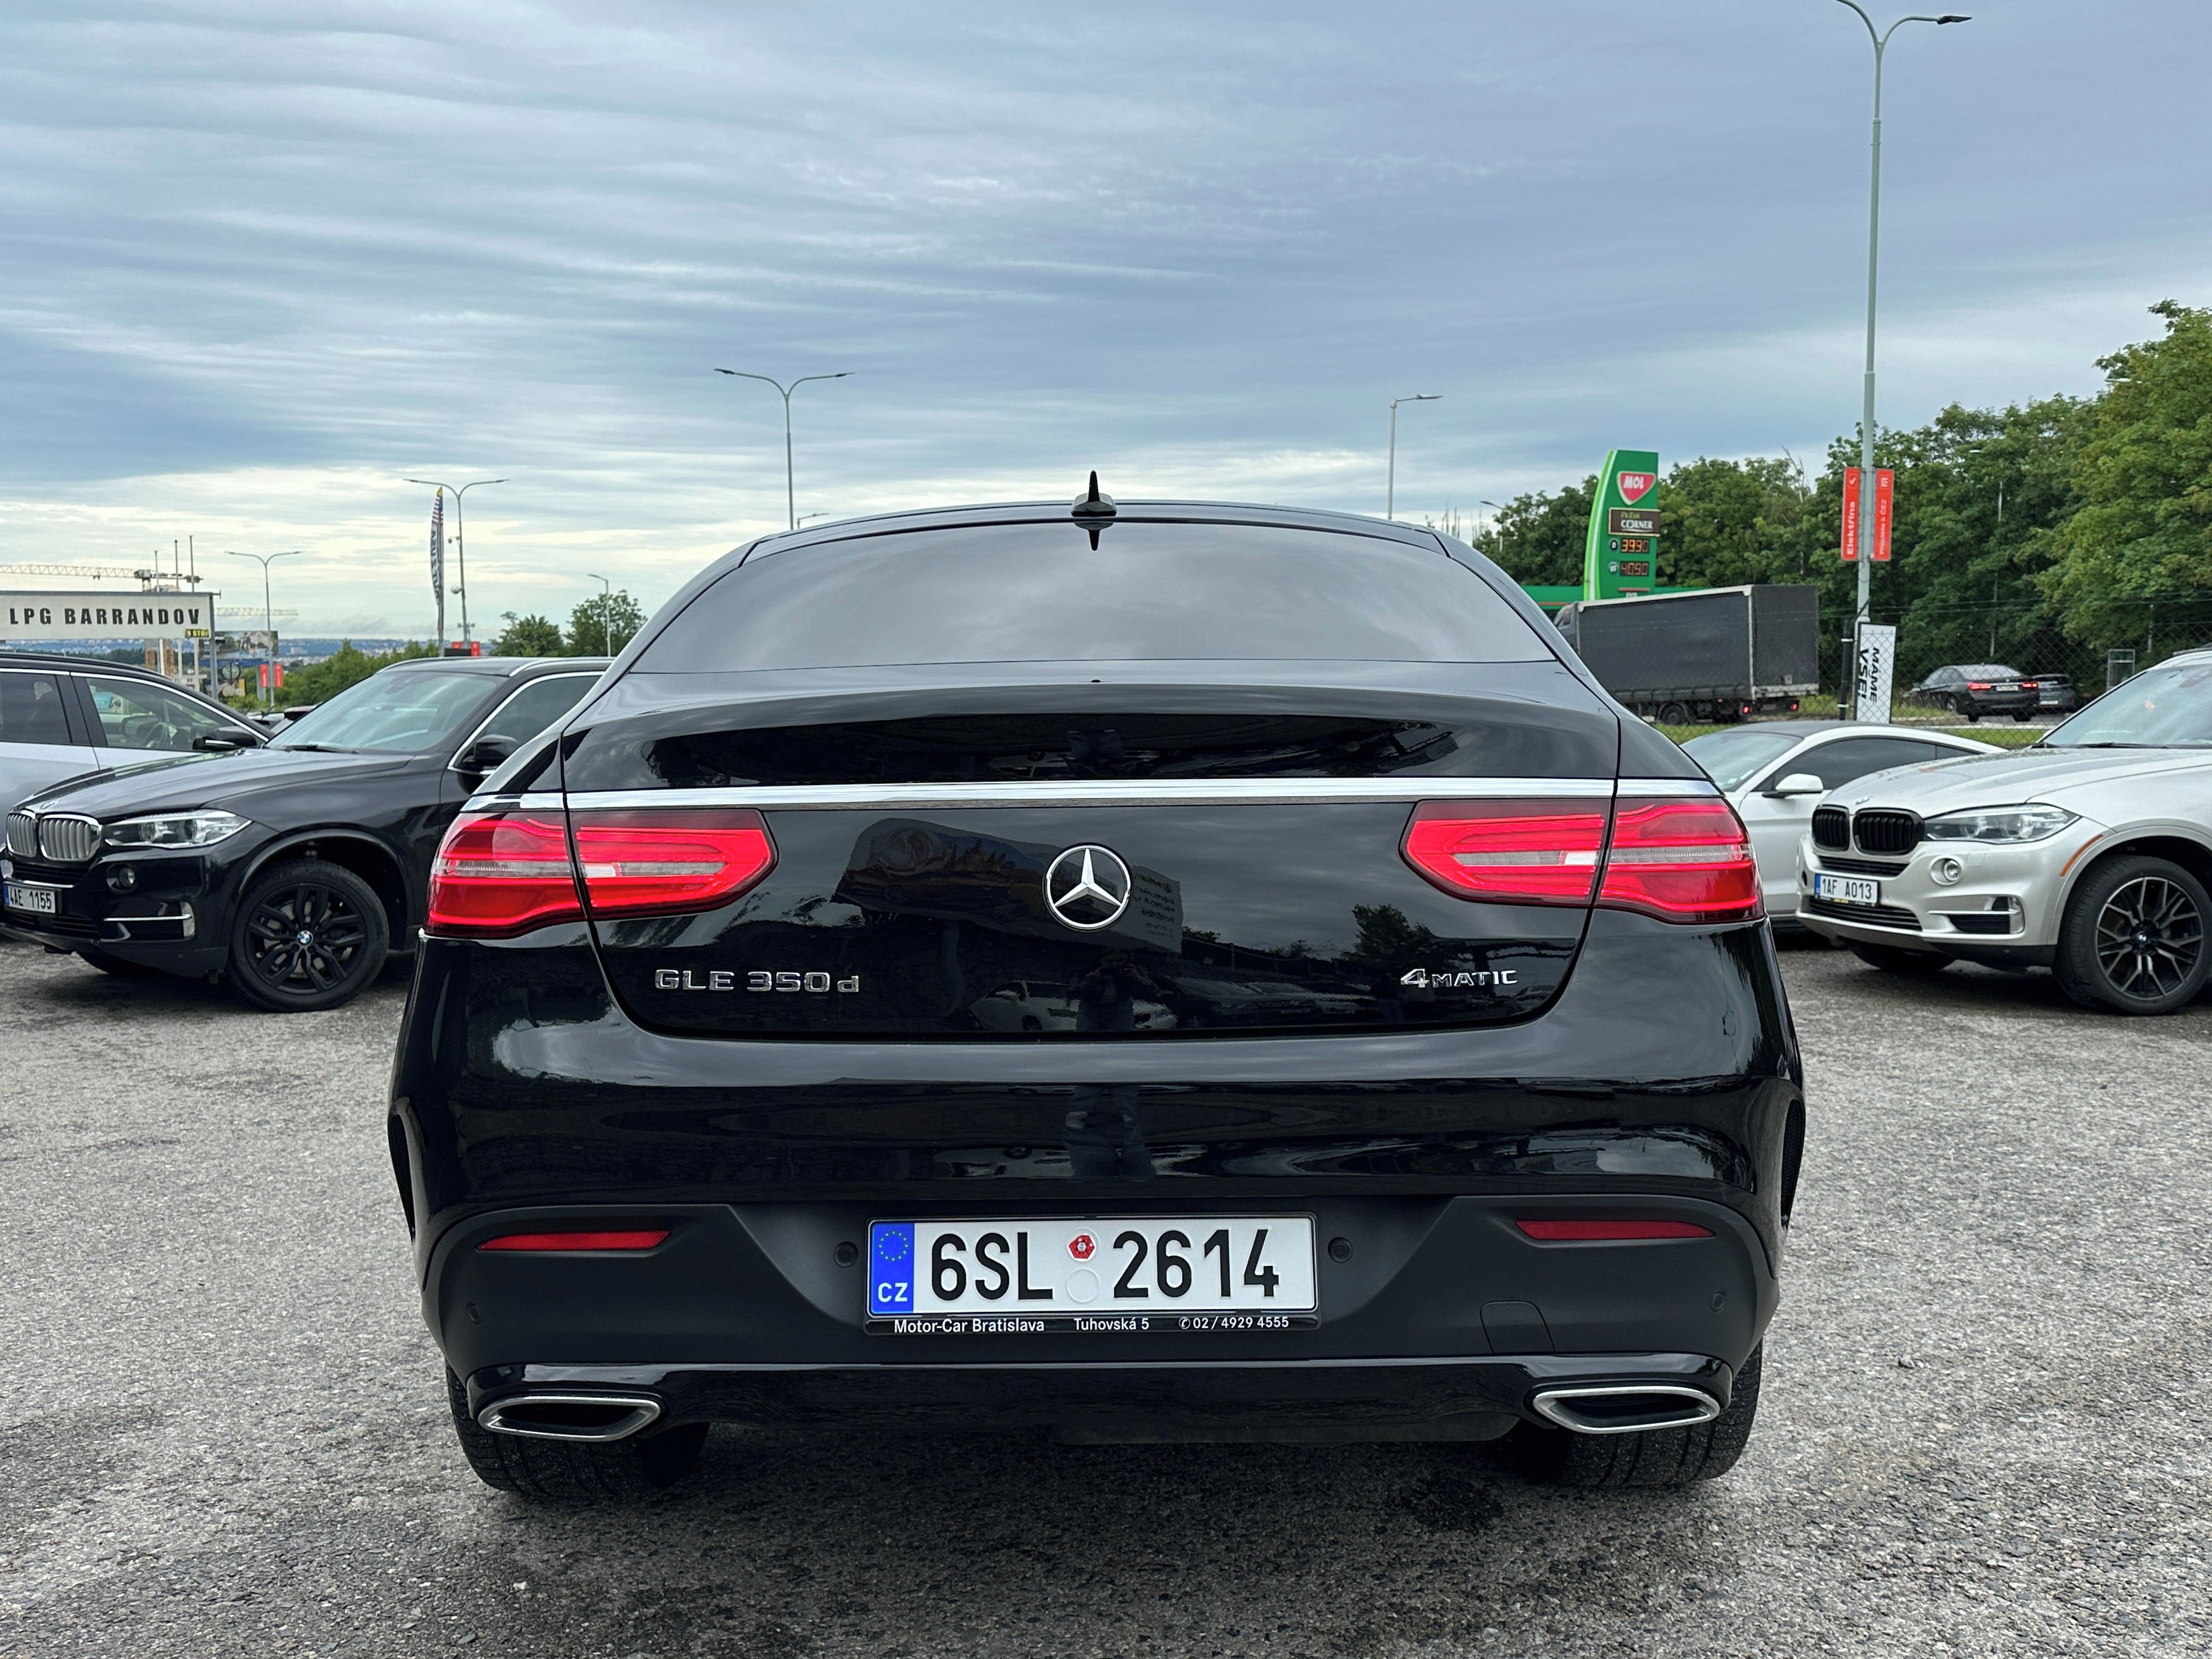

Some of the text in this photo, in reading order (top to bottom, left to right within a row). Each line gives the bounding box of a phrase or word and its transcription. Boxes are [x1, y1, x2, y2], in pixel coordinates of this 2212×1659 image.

[1623, 475, 1644, 489] MOL
[1621, 520, 1654, 529] CORNER
[1846, 501, 1856, 555] Elektřina
[9, 608, 199, 625] LPG BARRANDOV
[1870, 647, 1882, 703] MÁME
[1822, 878, 1871, 899] 1AF A013
[10, 888, 52, 910] 4AE 1155
[655, 969, 735, 991] GLE
[1400, 968, 1518, 988] 4MATIC
[931, 1229, 1280, 1301] 6SL 2614
[878, 1282, 908, 1303] CZ
[894, 1318, 1045, 1333] Motor-Car Bratislava
[1074, 1318, 1149, 1330] Tuhovská 5
[1257, 1317, 1289, 1328] 4555
